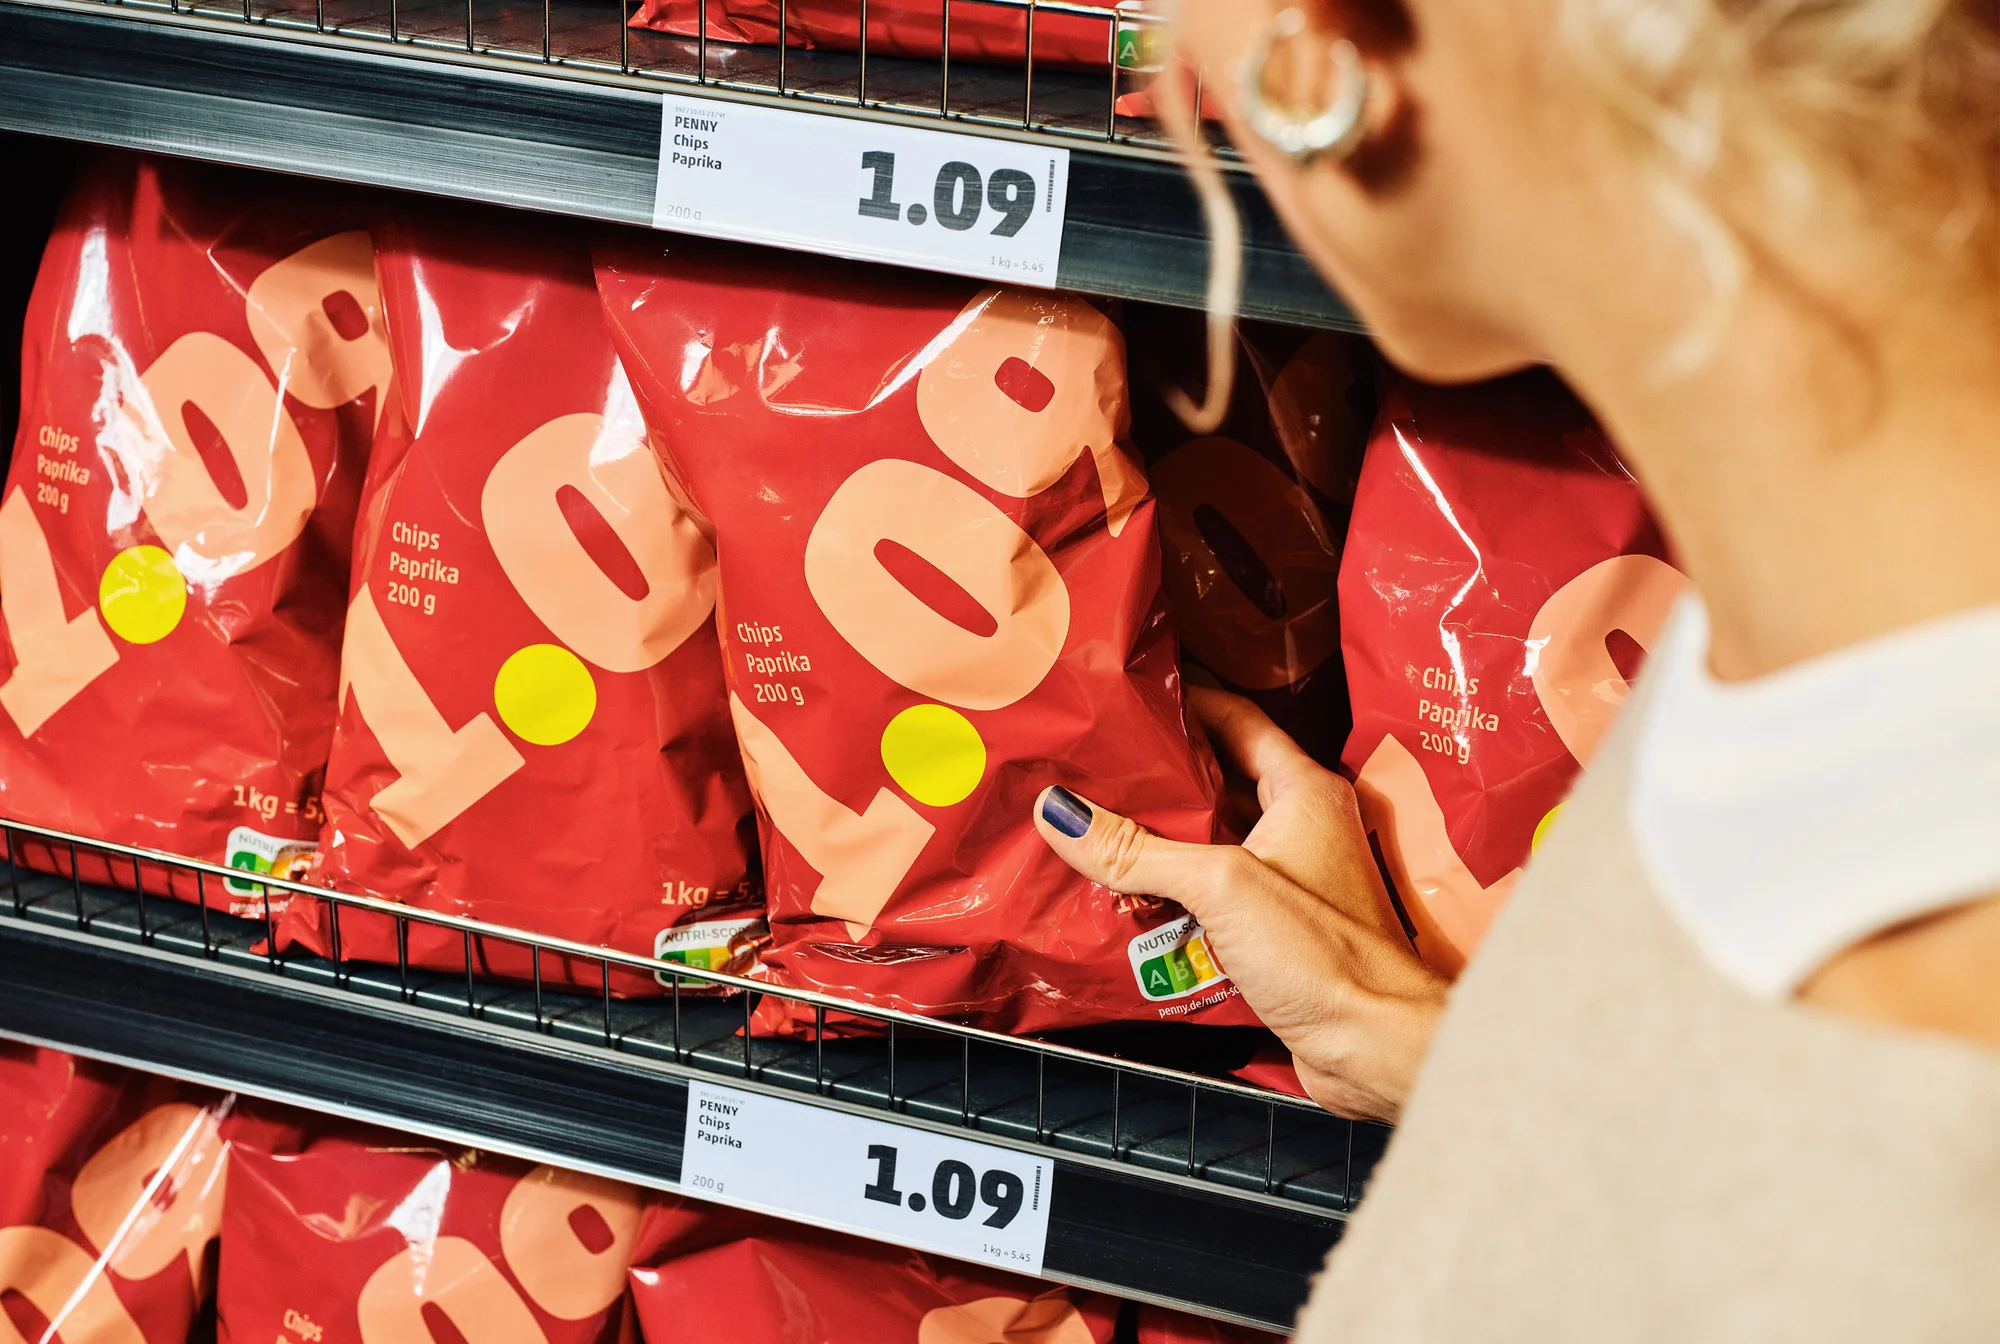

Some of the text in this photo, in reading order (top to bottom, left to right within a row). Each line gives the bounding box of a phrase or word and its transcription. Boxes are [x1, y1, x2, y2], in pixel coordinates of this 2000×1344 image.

[675, 116, 718, 132] PENNY
[674, 134, 709, 151] Chips
[672, 152, 723, 170] Paprika
[858, 150, 1036, 237] 1.09
[667, 205, 691, 219] 200
[991, 256, 996, 266] 1
[999, 257, 1010, 269] kg
[1021, 261, 1044, 273] 5.45
[39, 425, 79, 454] Chips
[37, 453, 91, 486] Paprika
[37, 482, 69, 515] 200 g
[392, 521, 440, 552] Chips
[389, 551, 460, 584] Paprika
[387, 581, 436, 615] 200 g
[730, 286, 1149, 943] 1.09
[737, 621, 783, 647] Chips
[745, 651, 811, 677] Paprika
[753, 683, 805, 706] 200 g
[1423, 667, 1479, 697] Chips
[1419, 699, 1499, 732] Paprika
[1420, 731, 1471, 765] 200 g
[233, 785, 279, 819] 1kg
[661, 880, 709, 910] 1kg
[734, 882, 764, 903] 5,
[1150, 969, 1168, 989] A
[700, 1099, 739, 1116] PENNY
[699, 1115, 730, 1130] Chips
[697, 1130, 743, 1149] Paprika
[692, 1175, 724, 1193] 200 g
[864, 1144, 1024, 1230] 1.09
[983, 1243, 987, 1252] 1
[991, 1243, 1001, 1257] kg
[1011, 1249, 1031, 1262] 5.45
